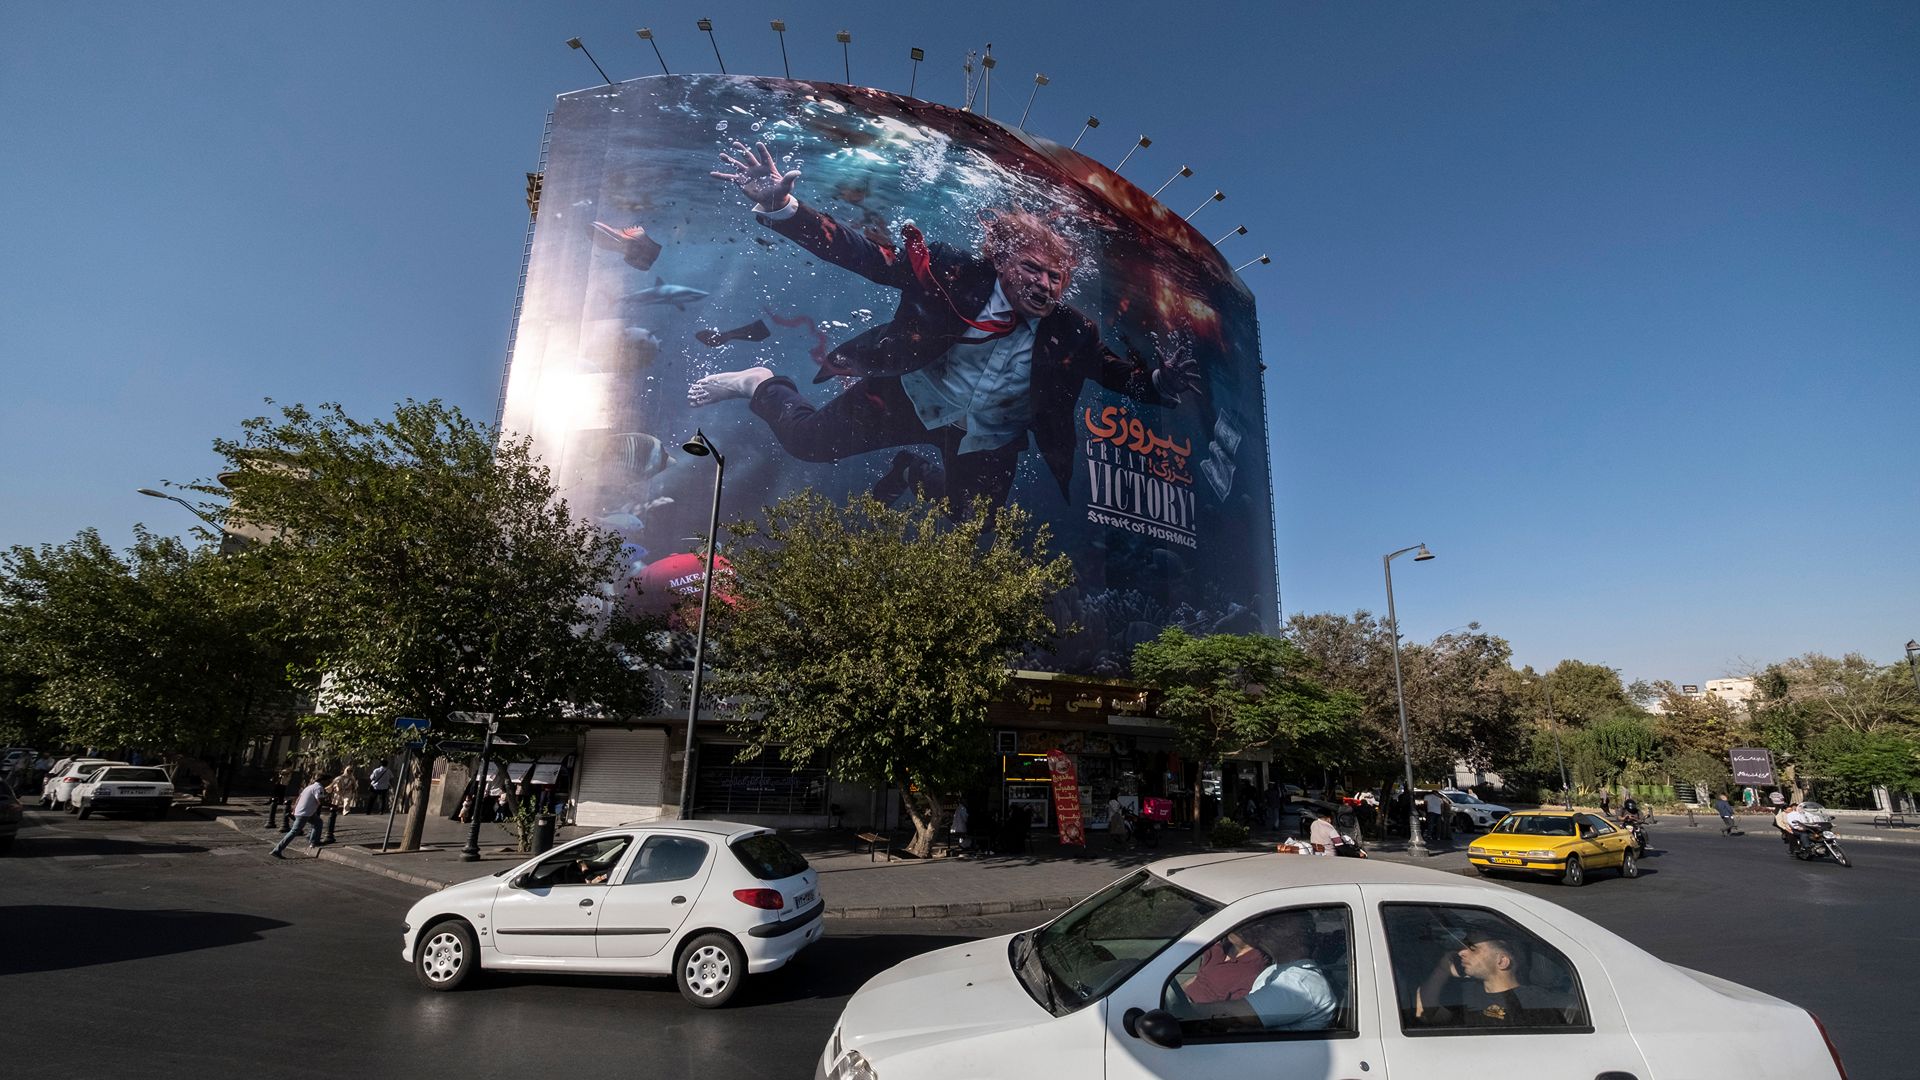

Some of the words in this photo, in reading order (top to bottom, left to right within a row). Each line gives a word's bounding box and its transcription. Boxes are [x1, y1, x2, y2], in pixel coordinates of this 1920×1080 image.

[1085, 406, 1192, 469] پیروزی
[1086, 439, 1146, 473] GREAT
[1087, 459, 1196, 531] VICTORY!
[1087, 510, 1131, 532] Strait
[669, 573, 700, 588] MAKE
[680, 701, 711, 710] REAH
